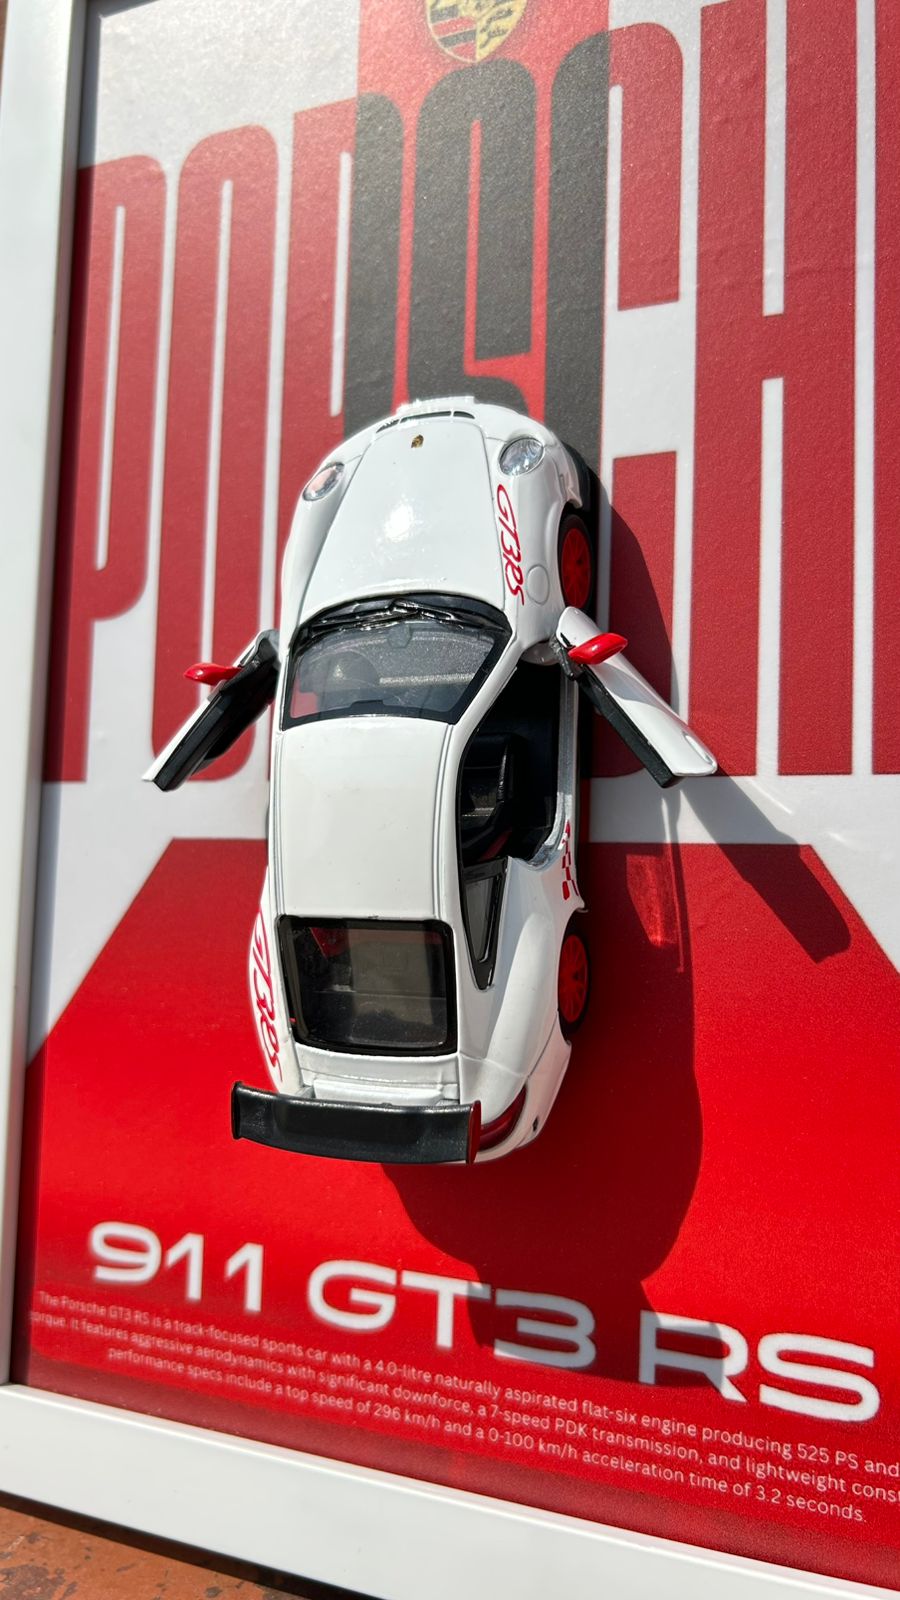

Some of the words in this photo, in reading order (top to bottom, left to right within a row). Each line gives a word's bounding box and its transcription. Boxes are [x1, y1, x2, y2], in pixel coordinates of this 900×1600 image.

[39, 1291, 60, 1307] The
[62, 1295, 106, 1317] Porsche
[110, 1308, 131, 1322] GT3
[134, 1312, 149, 1324] RS
[154, 1314, 162, 1328] is
[163, 1318, 171, 1329] a
[175, 1319, 259, 1348] track-focused
[262, 1336, 303, 1357] sports
[307, 1347, 327, 1362] car
[332, 1352, 360, 1369] with
[364, 1360, 371, 1370] a
[435, 1372, 501, 1399] naturally
[505, 1387, 578, 1412] aspirated
[582, 1399, 637, 1424] flat-six
[641, 1414, 698, 1436] engine
[702, 1426, 792, 1460] producing
[797, 1444, 830, 1463] 525
[835, 1450, 858, 1470] PS
[864, 1456, 900, 1478] and
[71, 1317, 79, 1330] It
[82, 1320, 128, 1341] features
[131, 1331, 193, 1354] aggressive
[196, 1345, 284, 1374] aerodynamics
[287, 1365, 316, 1380] with
[319, 1371, 389, 1396] significant
[394, 1386, 473, 1416] downforce,
[478, 1404, 486, 1416] a
[491, 1404, 550, 1430] 7-speed
[554, 1416, 588, 1437] PDK
[592, 1425, 703, 1464] transmission,
[708, 1451, 740, 1470] and
[746, 1458, 846, 1492] lightweight
[89, 1221, 265, 1313] 911
[307, 1259, 596, 1369] GT3
[638, 1310, 880, 1422] RS
[109, 1347, 184, 1373] performance
[188, 1361, 223, 1383] specs
[226, 1372, 272, 1392] include
[275, 1382, 282, 1395] a
[287, 1385, 309, 1402] top
[312, 1392, 353, 1410] speed
[357, 1397, 371, 1414] of
[374, 1401, 401, 1420] 296
[404, 1407, 440, 1428] km/h
[445, 1420, 472, 1437] and
[476, 1428, 484, 1439] a
[489, 1427, 534, 1449] 0-100
[539, 1438, 577, 1459] km/h
[582, 1449, 684, 1483] acceleration
[690, 1472, 728, 1492] time
[733, 1481, 752, 1498] of
[756, 1486, 781, 1504] 3.2
[786, 1493, 868, 1522] seconds.
